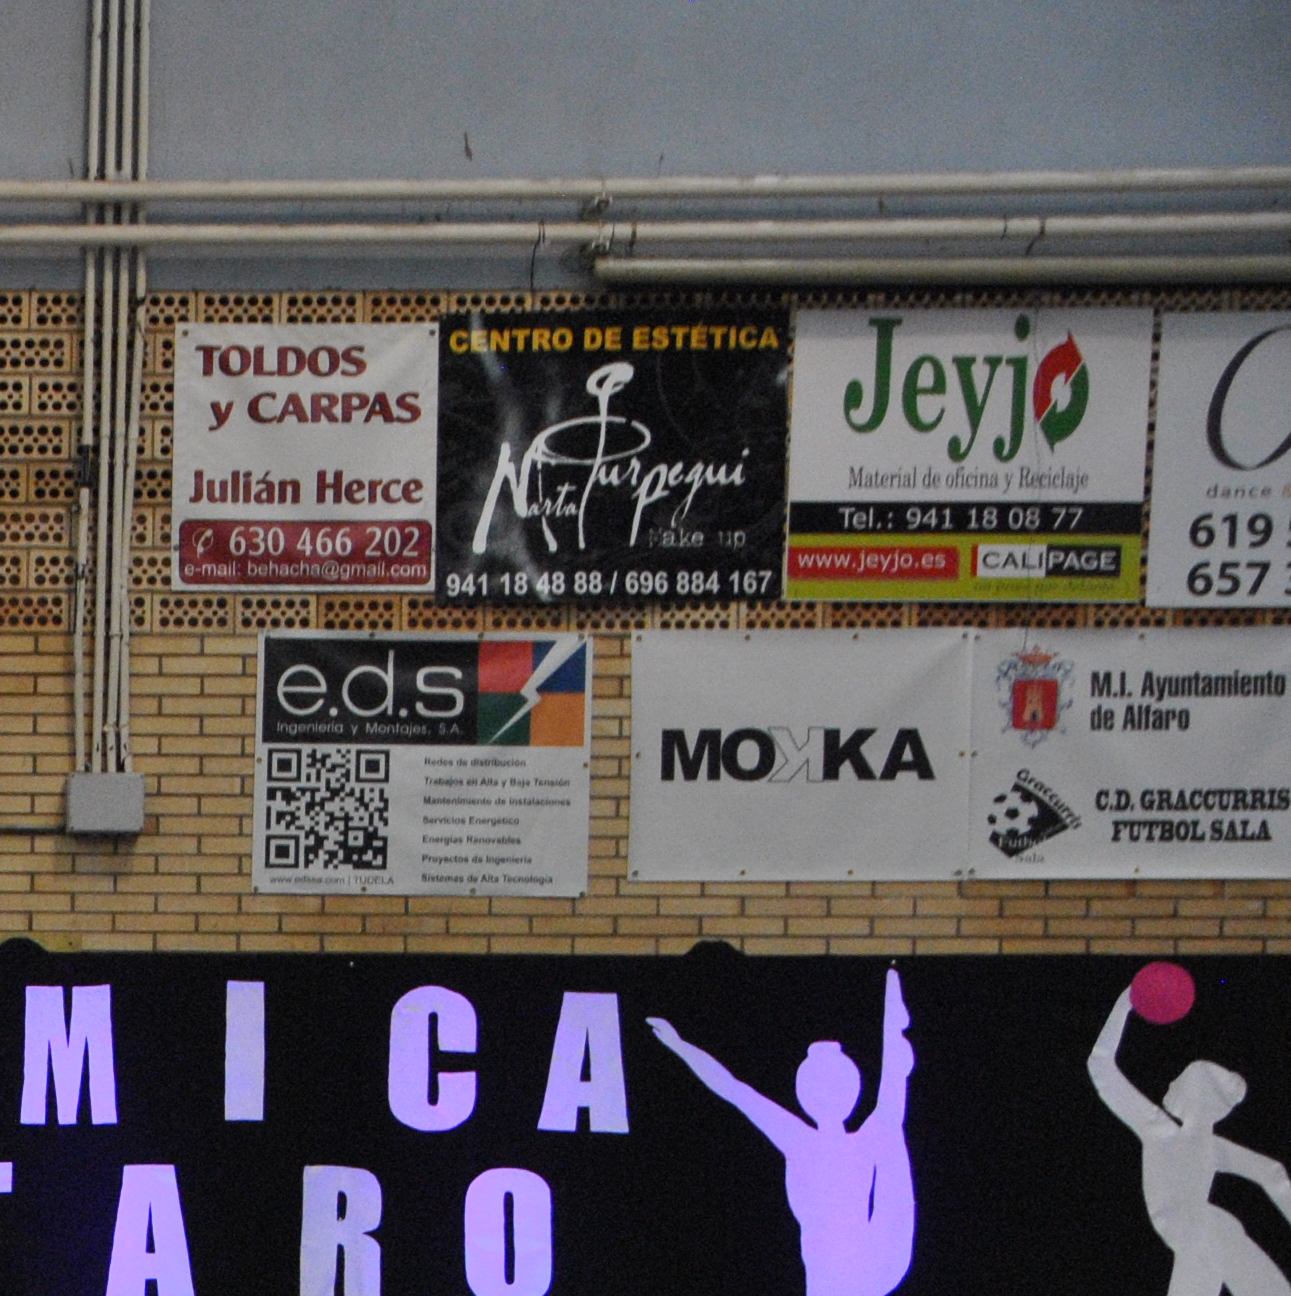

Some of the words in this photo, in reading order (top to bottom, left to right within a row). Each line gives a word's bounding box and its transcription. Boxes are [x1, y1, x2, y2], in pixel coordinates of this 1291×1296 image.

[449, 328, 573, 352] CENTRO
[584, 326, 623, 350] DE
[632, 325, 780, 349] ESTÉTICA
[195, 345, 367, 377] TOLDOS
[208, 401, 234, 431] y
[247, 392, 422, 423] CARPAS
[189, 470, 301, 504] Julián
[316, 470, 423, 504] Herce
[848, 466, 918, 490] Material
[922, 467, 941, 489] de
[945, 466, 999, 490] oficina
[1003, 472, 1013, 493] y
[1019, 466, 1089, 493] Reciclaje
[1206, 483, 1272, 499] dance
[838, 506, 894, 530] Tel.:
[906, 507, 953, 530] 941
[969, 507, 998, 530] 18
[1008, 507, 1041, 530] 08
[1051, 507, 1084, 530] 77
[1189, 512, 1273, 549] 619
[229, 526, 285, 556] 630
[296, 527, 352, 557] 466
[364, 527, 420, 557] 202
[184, 561, 241, 577] e-mail:
[247, 560, 427, 581] behacha@gmail.com
[797, 550, 946, 573] www.jeyjo.es
[445, 573, 488, 597] 941
[501, 573, 528, 596] 18
[536, 572, 566, 595] 48
[574, 572, 603, 595] 88
[625, 571, 668, 595] 696
[676, 571, 720, 594] 884
[730, 570, 772, 593] 167
[1187, 561, 1271, 597] 657
[277, 649, 465, 718] e.d.s
[1090, 670, 1133, 697] M.I.
[1140, 669, 1286, 702] Ayuntamiento
[351, 725, 359, 736] y
[1090, 704, 1115, 731] de
[1122, 704, 1190, 732] Alfaro
[1095, 789, 1135, 811] C.D.
[1140, 788, 1291, 811] GRACCURRIS
[1111, 820, 1206, 842] FUTBOL
[1209, 819, 1272, 842] SALA
